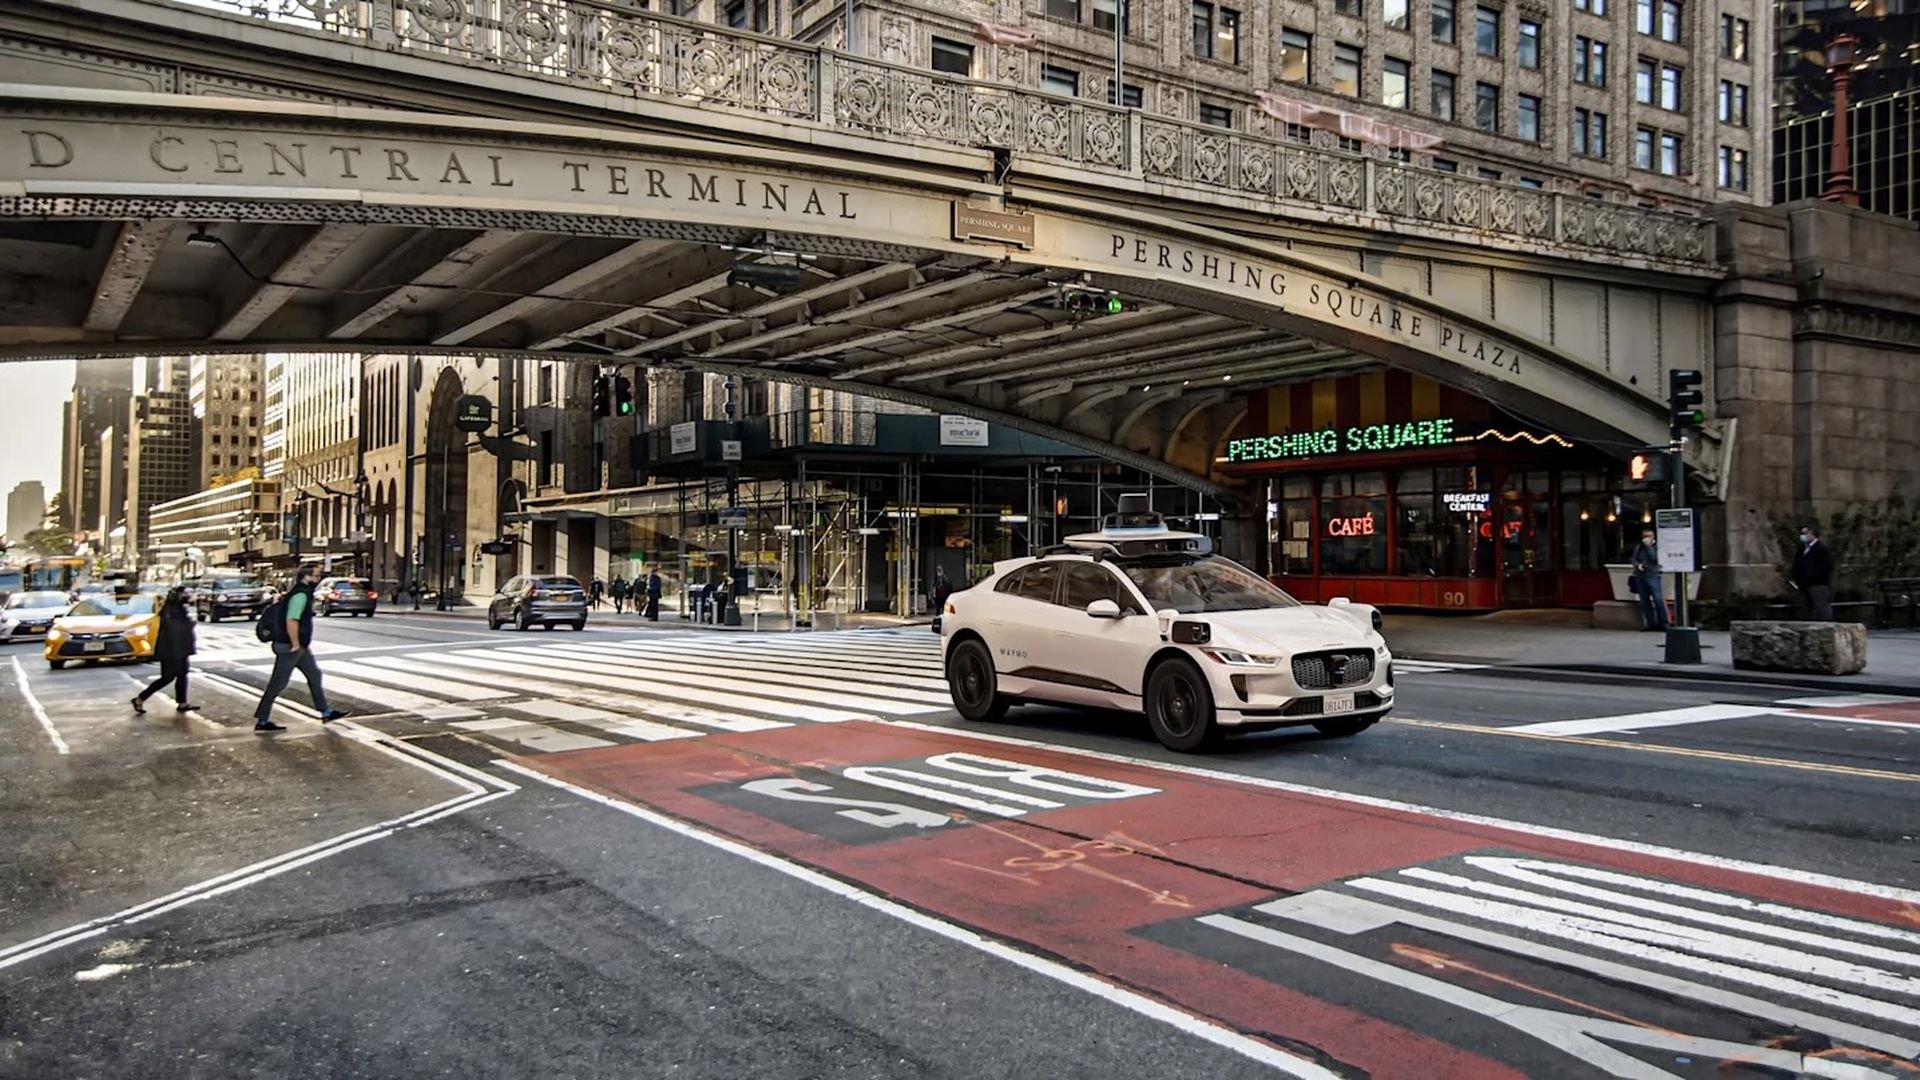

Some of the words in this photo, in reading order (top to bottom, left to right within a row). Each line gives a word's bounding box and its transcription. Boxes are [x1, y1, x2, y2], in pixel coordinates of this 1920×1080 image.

[149, 136, 515, 188] CENTRAL
[562, 160, 857, 220] TERMINAL
[960, 215, 1000, 229] PERSHING
[1001, 222, 1032, 234] SQUARE
[1111, 233, 1287, 297] PERSHING
[1309, 283, 1423, 338] SQUARE
[1442, 326, 1522, 375] PLAZA
[1228, 430, 1338, 462] PERSHING
[1346, 418, 1454, 451] SQUARE
[1443, 493, 1490, 503] BREAKFAST
[1449, 502, 1486, 512] CENTRAL
[1328, 512, 1375, 537] CAFÉ
[1444, 591, 1465, 606] 90
[999, 647, 1029, 658] WAYMO
[740, 752, 1163, 829] BUS
